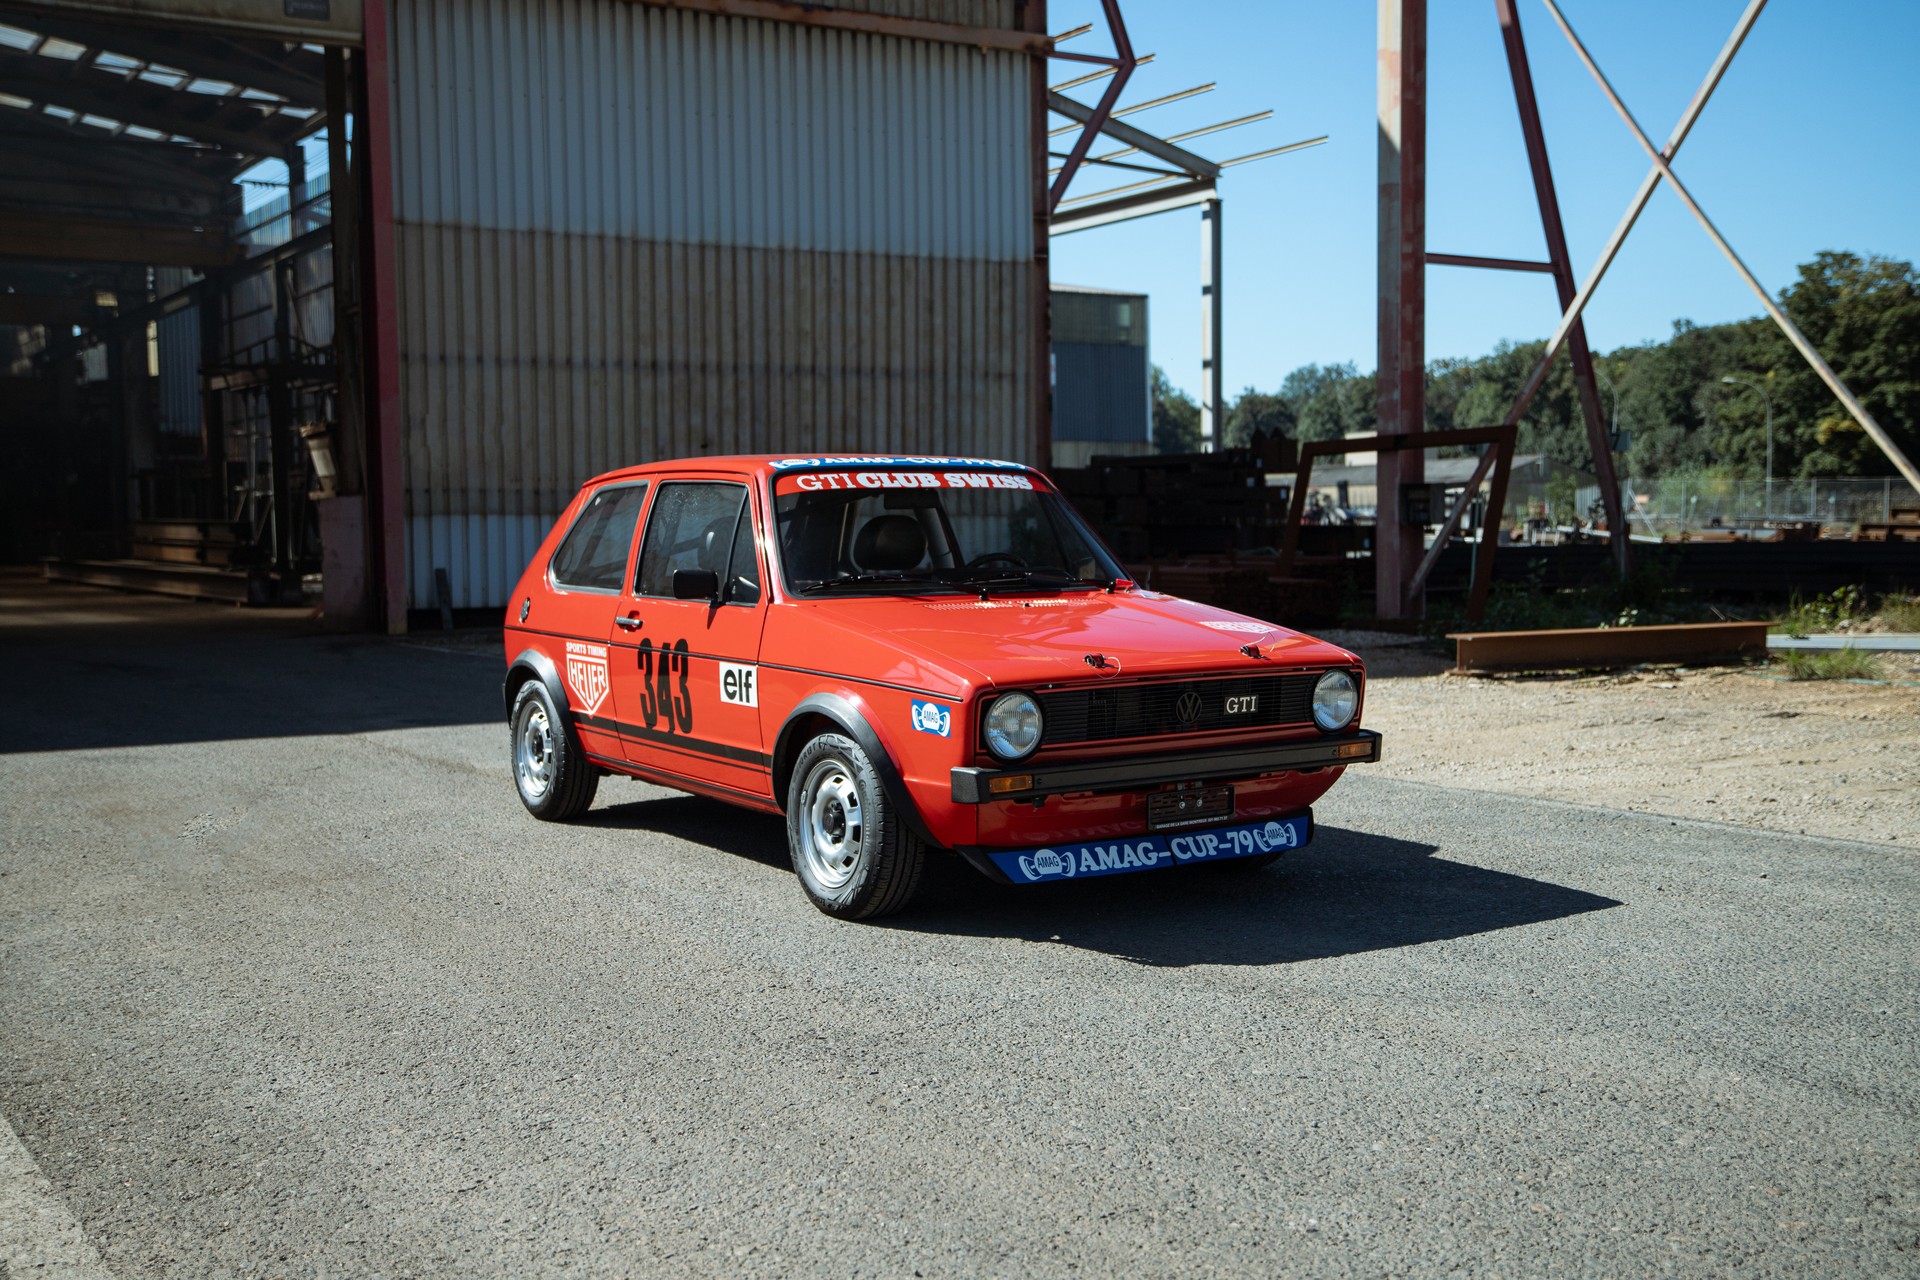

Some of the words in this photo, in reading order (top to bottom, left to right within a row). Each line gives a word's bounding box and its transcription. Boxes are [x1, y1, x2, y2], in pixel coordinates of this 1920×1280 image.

[796, 473, 857, 491] GTI
[856, 472, 941, 488] CLUB
[943, 473, 1034, 490] SWISS
[566, 642, 586, 655] SPORTS
[587, 645, 607, 658] TIMING
[570, 661, 606, 703] HEUER
[637, 637, 693, 734] 343
[723, 669, 753, 703] elf
[923, 710, 938, 723] AMAG
[1226, 695, 1257, 714] GTI
[1037, 855, 1059, 869] AMAG
[1080, 830, 1254, 872] AMAG-CUP-79
[1266, 827, 1284, 841] AMAG
